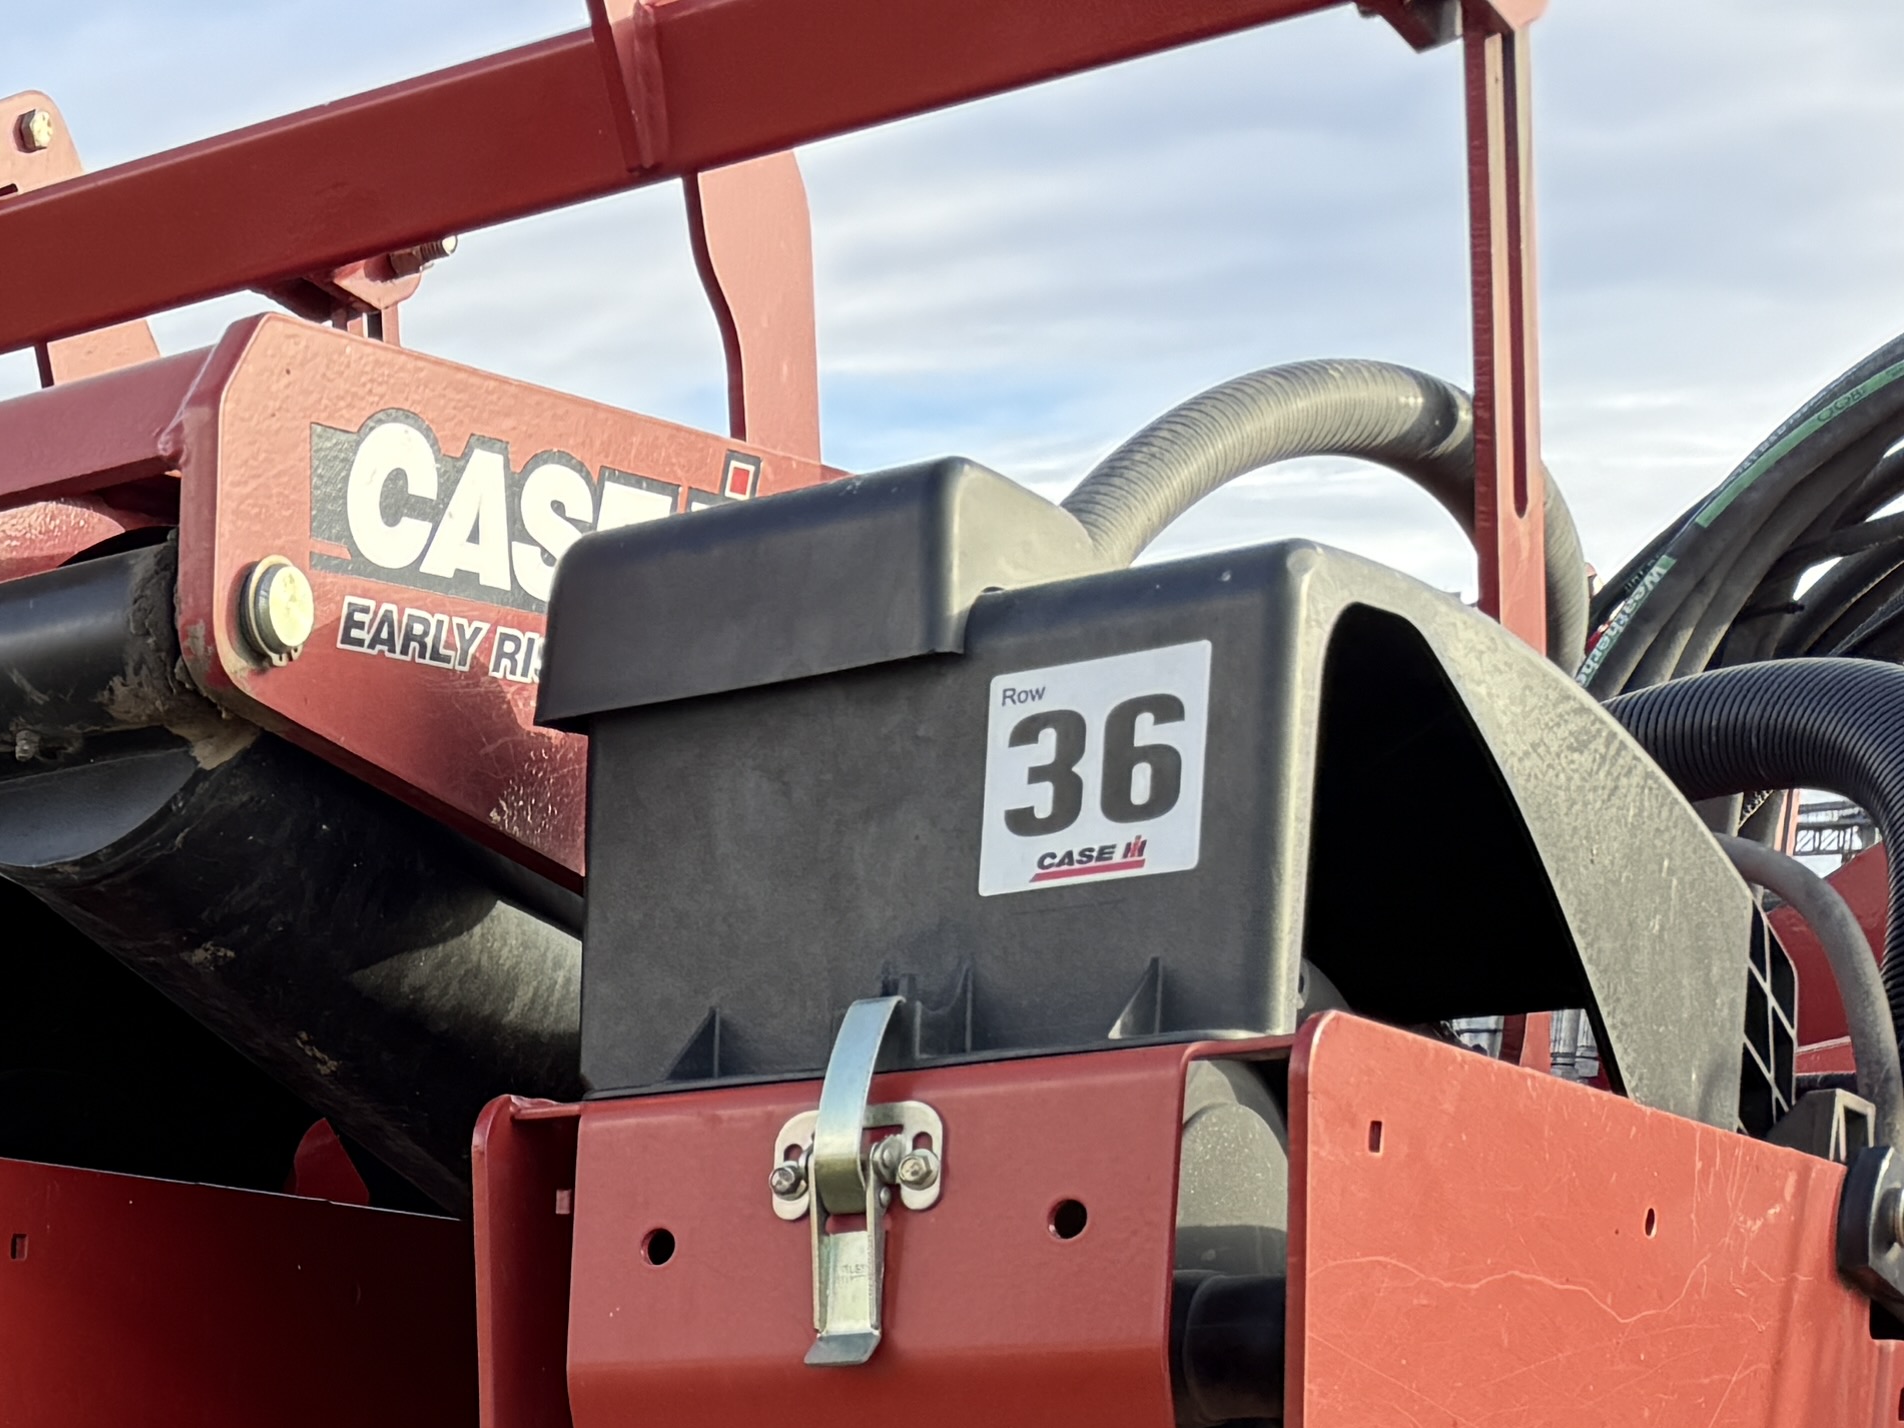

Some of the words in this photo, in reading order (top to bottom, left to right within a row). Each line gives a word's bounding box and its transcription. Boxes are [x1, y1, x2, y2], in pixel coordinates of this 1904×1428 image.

[346, 421, 676, 603] CAS
[338, 595, 491, 672] EARLY
[1001, 686, 1046, 706] Row
[1003, 692, 1186, 838] 36
[1036, 843, 1117, 871] CASE
